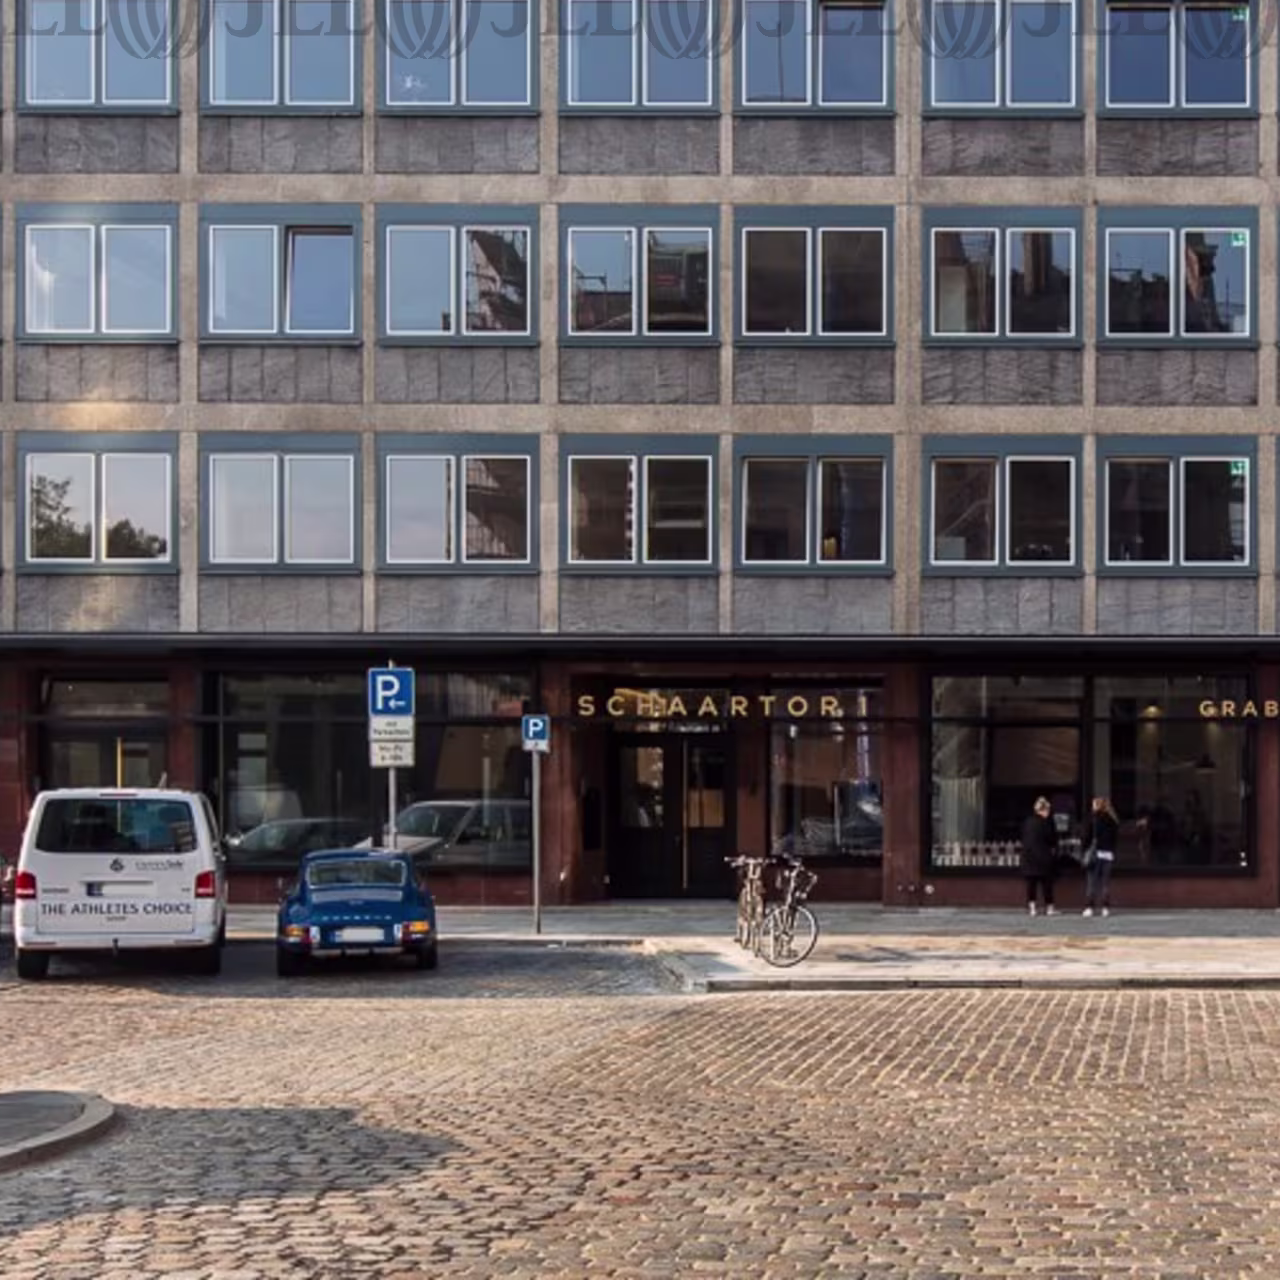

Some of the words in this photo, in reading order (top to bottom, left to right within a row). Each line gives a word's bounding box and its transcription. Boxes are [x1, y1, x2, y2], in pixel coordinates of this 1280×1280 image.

[376, 675, 400, 710] P
[578, 695, 840, 716] SCHAARTOR
[529, 718, 543, 738] P
[41, 903, 64, 915] THE
[71, 903, 140, 915] ATHLETES
[143, 903, 193, 915] CHOICE
